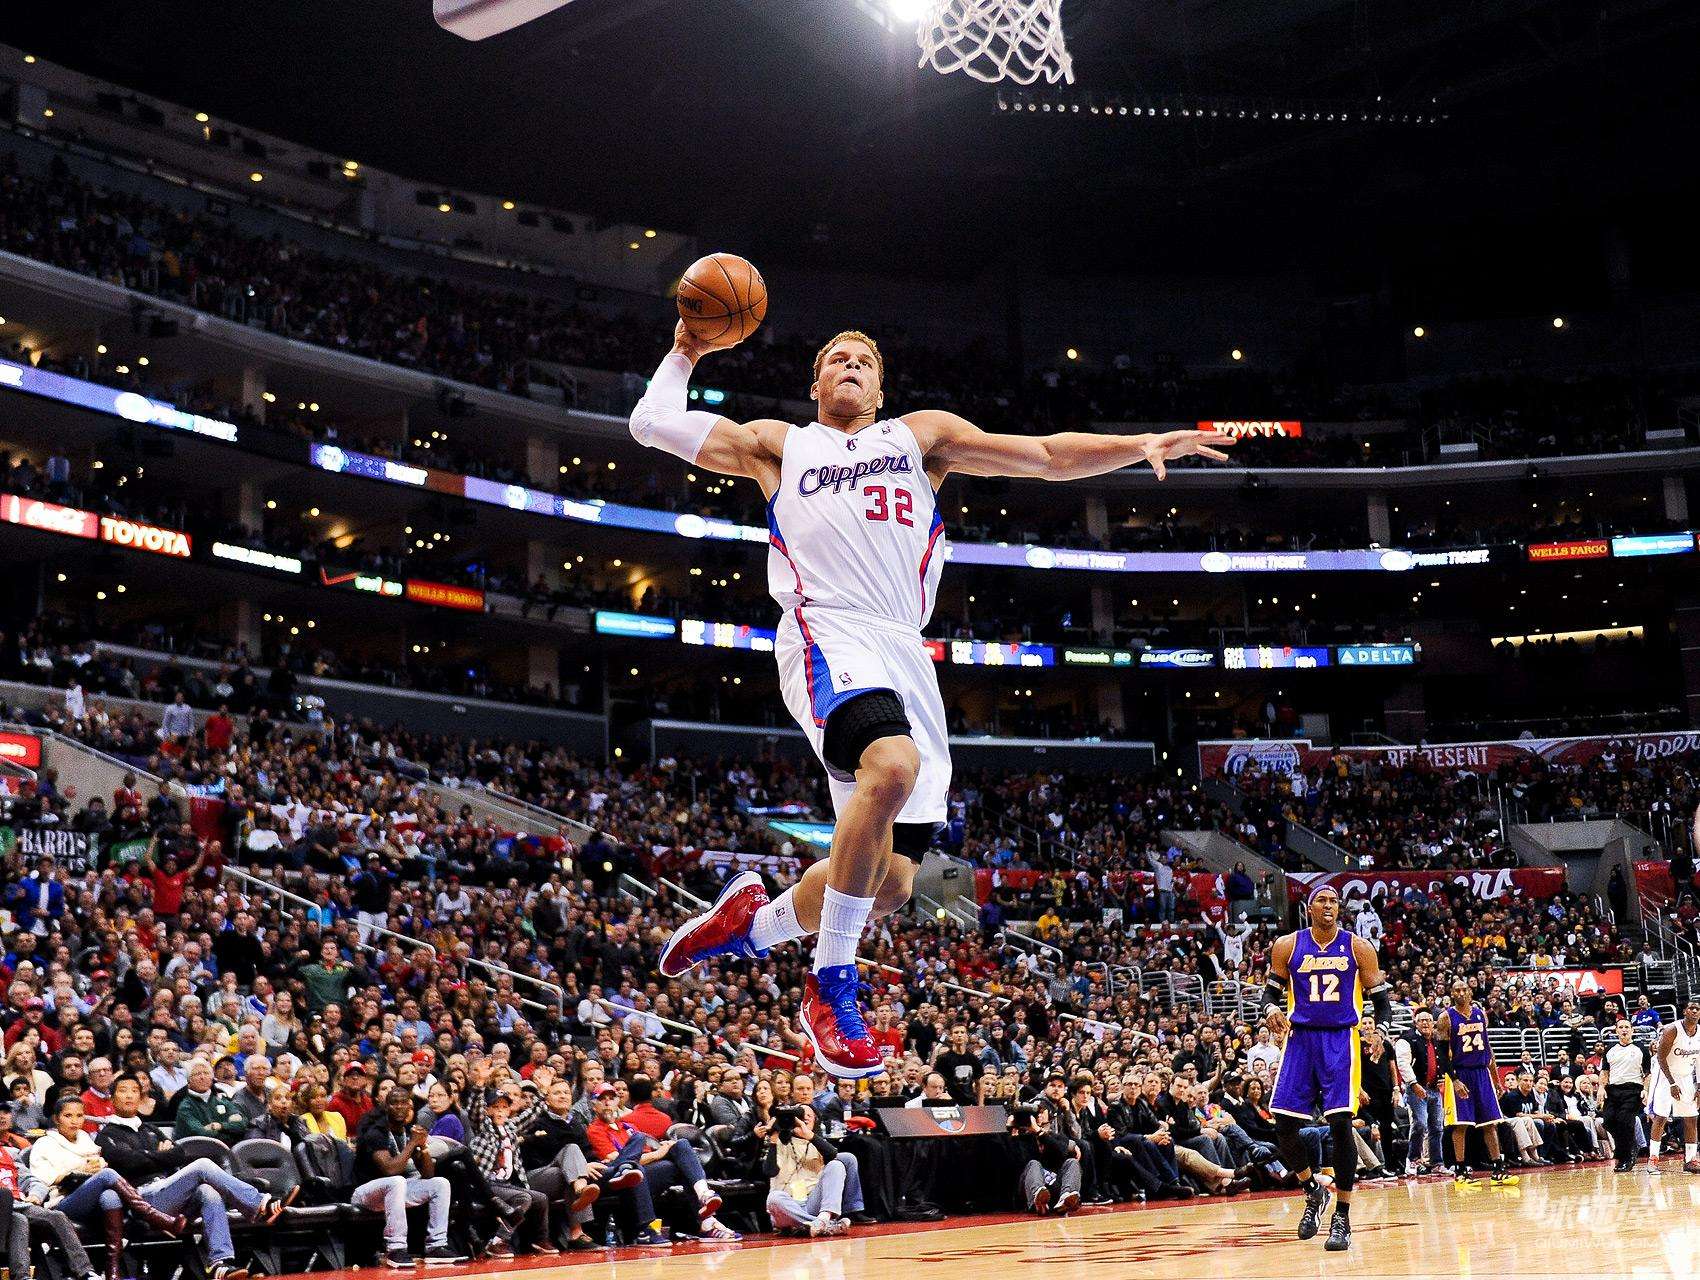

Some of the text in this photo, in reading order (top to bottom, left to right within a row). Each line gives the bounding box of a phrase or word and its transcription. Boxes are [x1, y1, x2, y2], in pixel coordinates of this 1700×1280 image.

[798, 454, 914, 498] Clippers
[863, 485, 914, 528] 32
[101, 517, 191, 557] TOYOTA
[1529, 547, 1569, 558] WELLS
[1570, 544, 1608, 556] FARGO
[1358, 649, 1414, 662] DELTA
[1297, 954, 1350, 973] LAKERS
[1308, 973, 1340, 1002] 12
[1462, 1033, 1485, 1053] 24
